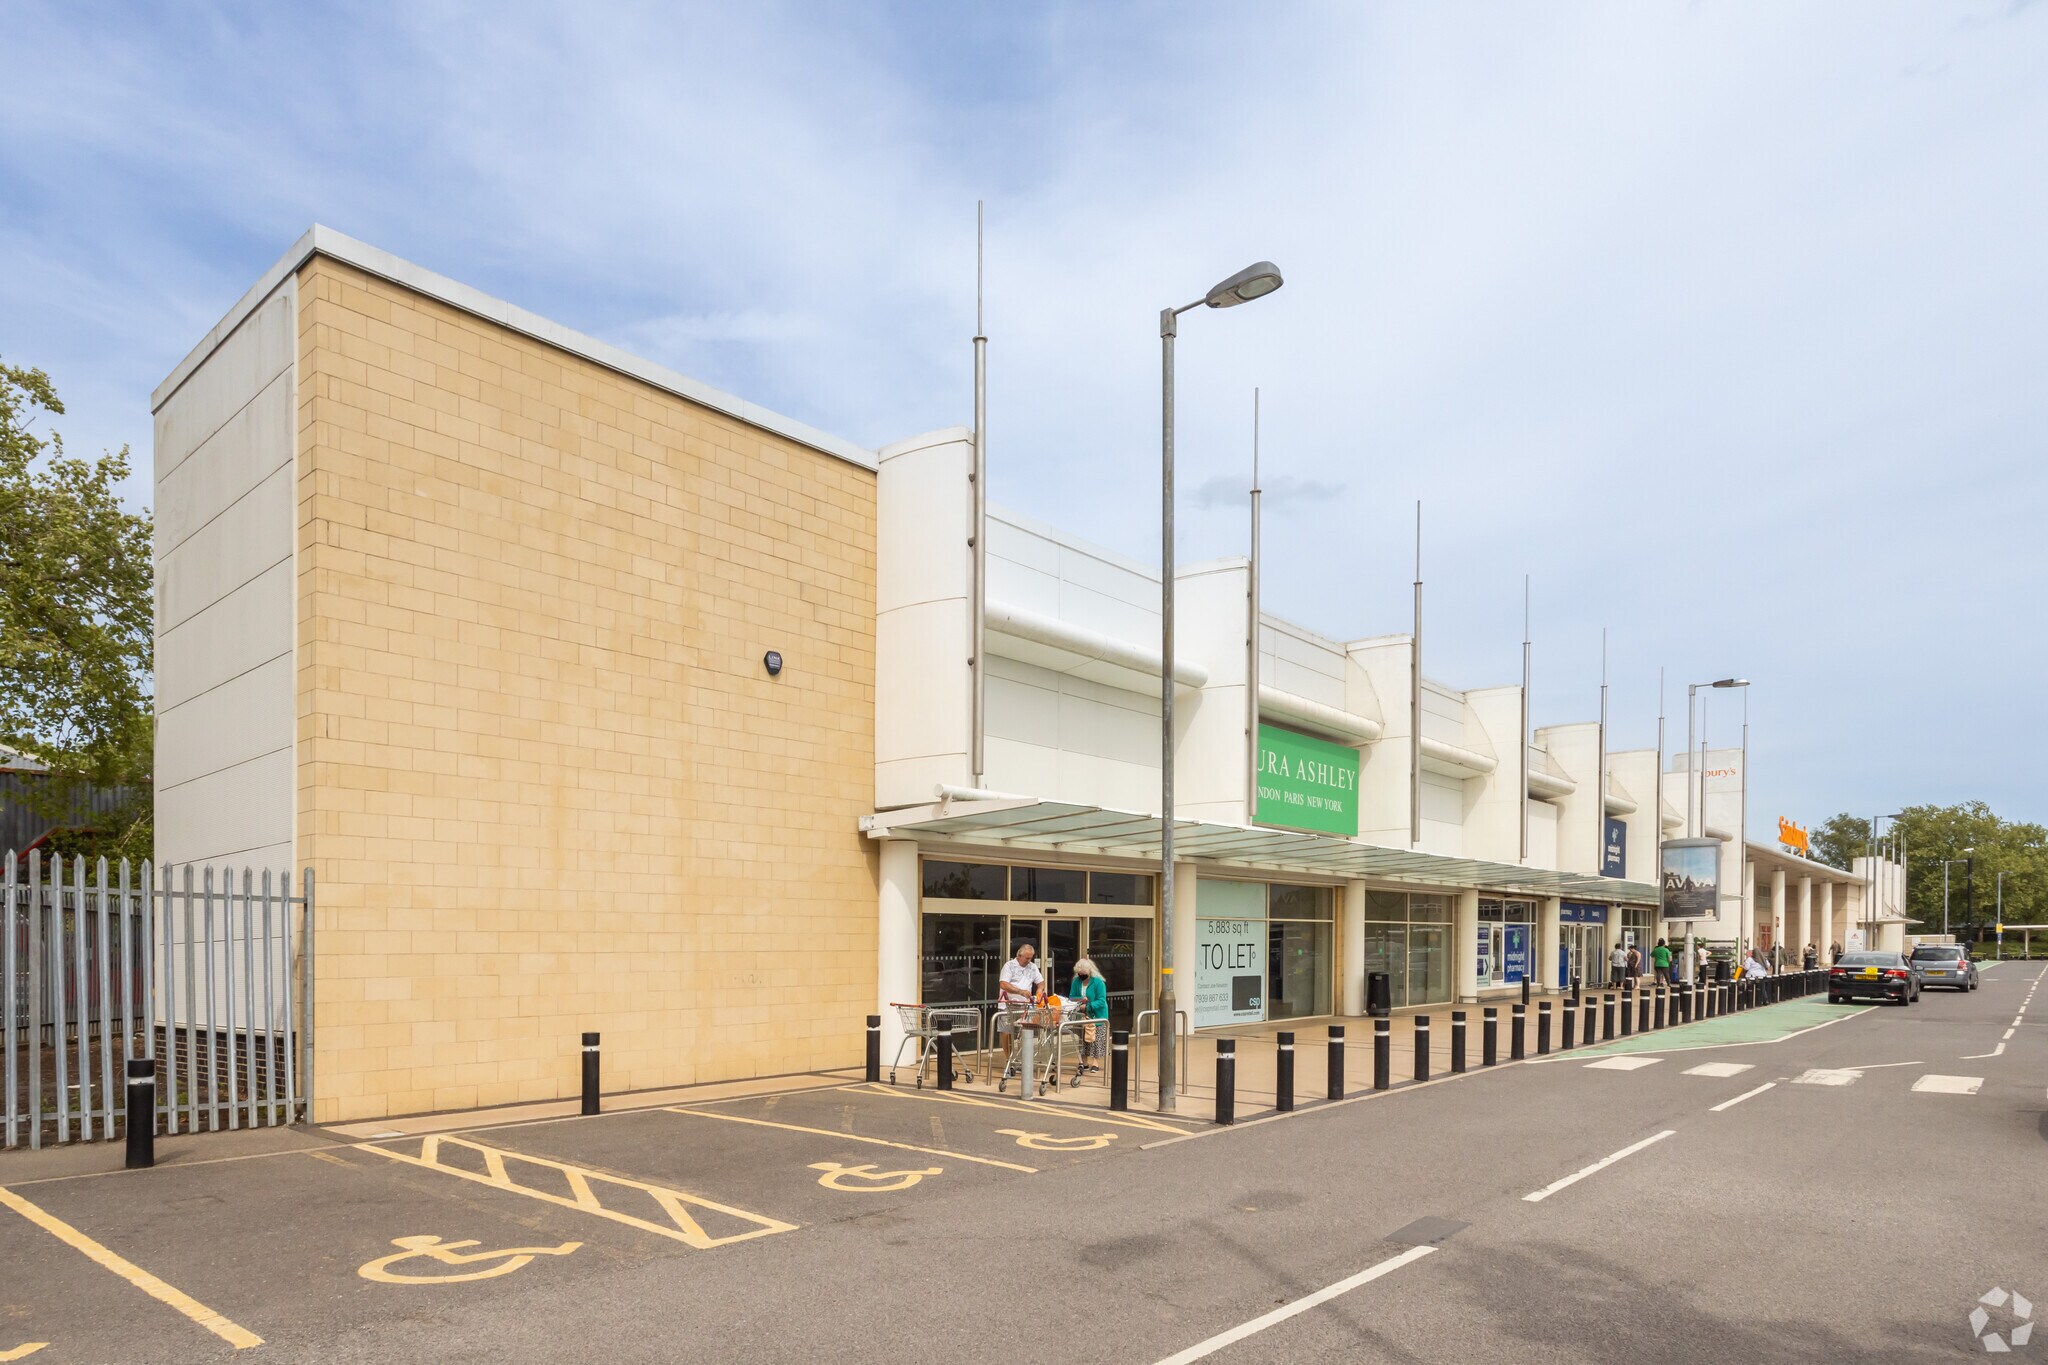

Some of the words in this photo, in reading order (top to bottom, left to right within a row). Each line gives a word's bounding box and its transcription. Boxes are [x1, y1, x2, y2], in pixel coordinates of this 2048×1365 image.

[1296, 758, 1355, 791] ASHLEY
[1283, 790, 1304, 806] PARIS
[1307, 795, 1323, 808] NEW
[1324, 798, 1342, 813] YORK
[1665, 878, 1714, 889] AVVA
[1208, 920, 1230, 935] 5,883
[1232, 923, 1242, 936] sq
[1201, 943, 1224, 970] TO
[1228, 943, 1255, 969] LET
[1507, 951, 1525, 963] midnight
[1506, 963, 1525, 974] pharmacy
